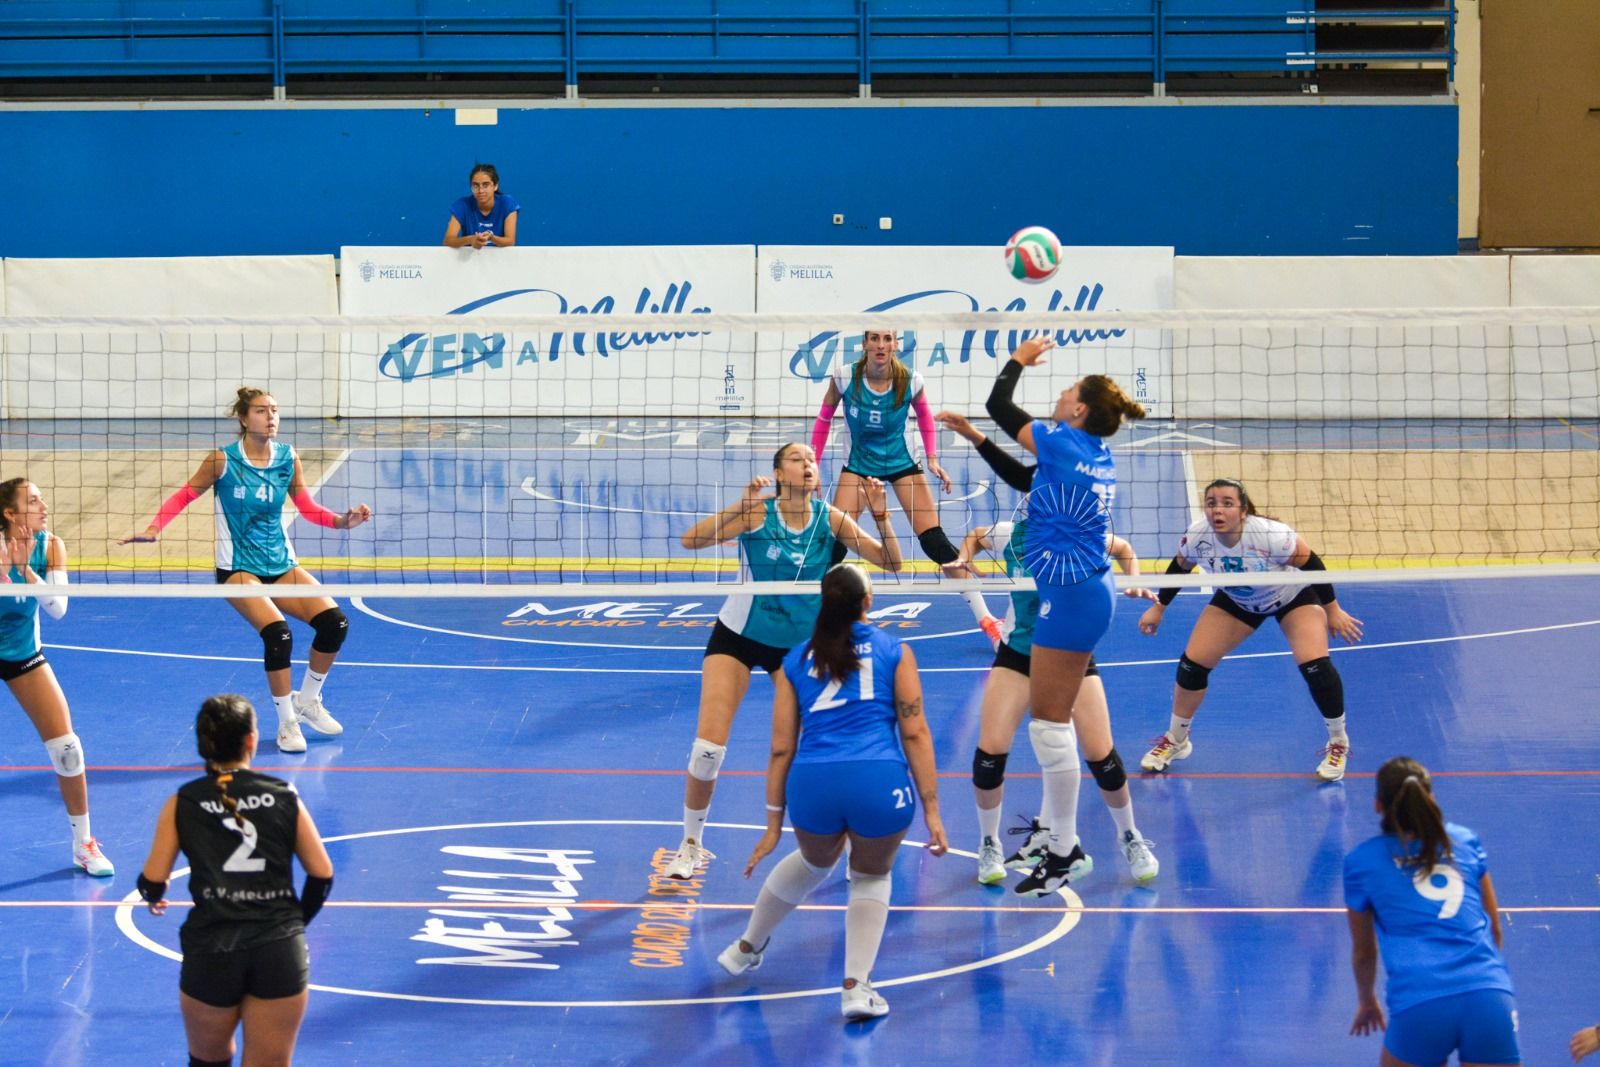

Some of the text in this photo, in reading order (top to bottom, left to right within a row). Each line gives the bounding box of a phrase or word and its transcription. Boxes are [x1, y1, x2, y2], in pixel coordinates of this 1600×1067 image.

[379, 269, 422, 279] MELILLA
[790, 269, 833, 279] MELILLA
[387, 332, 503, 383] VEN
[516, 340, 539, 366] A
[928, 342, 950, 367] A
[869, 410, 882, 424] 8
[255, 483, 274, 503] 41
[807, 656, 875, 713] 21
[200, 793, 275, 813] RUADO
[892, 786, 913, 809] 21
[222, 817, 266, 872] 2
[1412, 863, 1465, 919] 9
[409, 845, 597, 970] MELILLA
